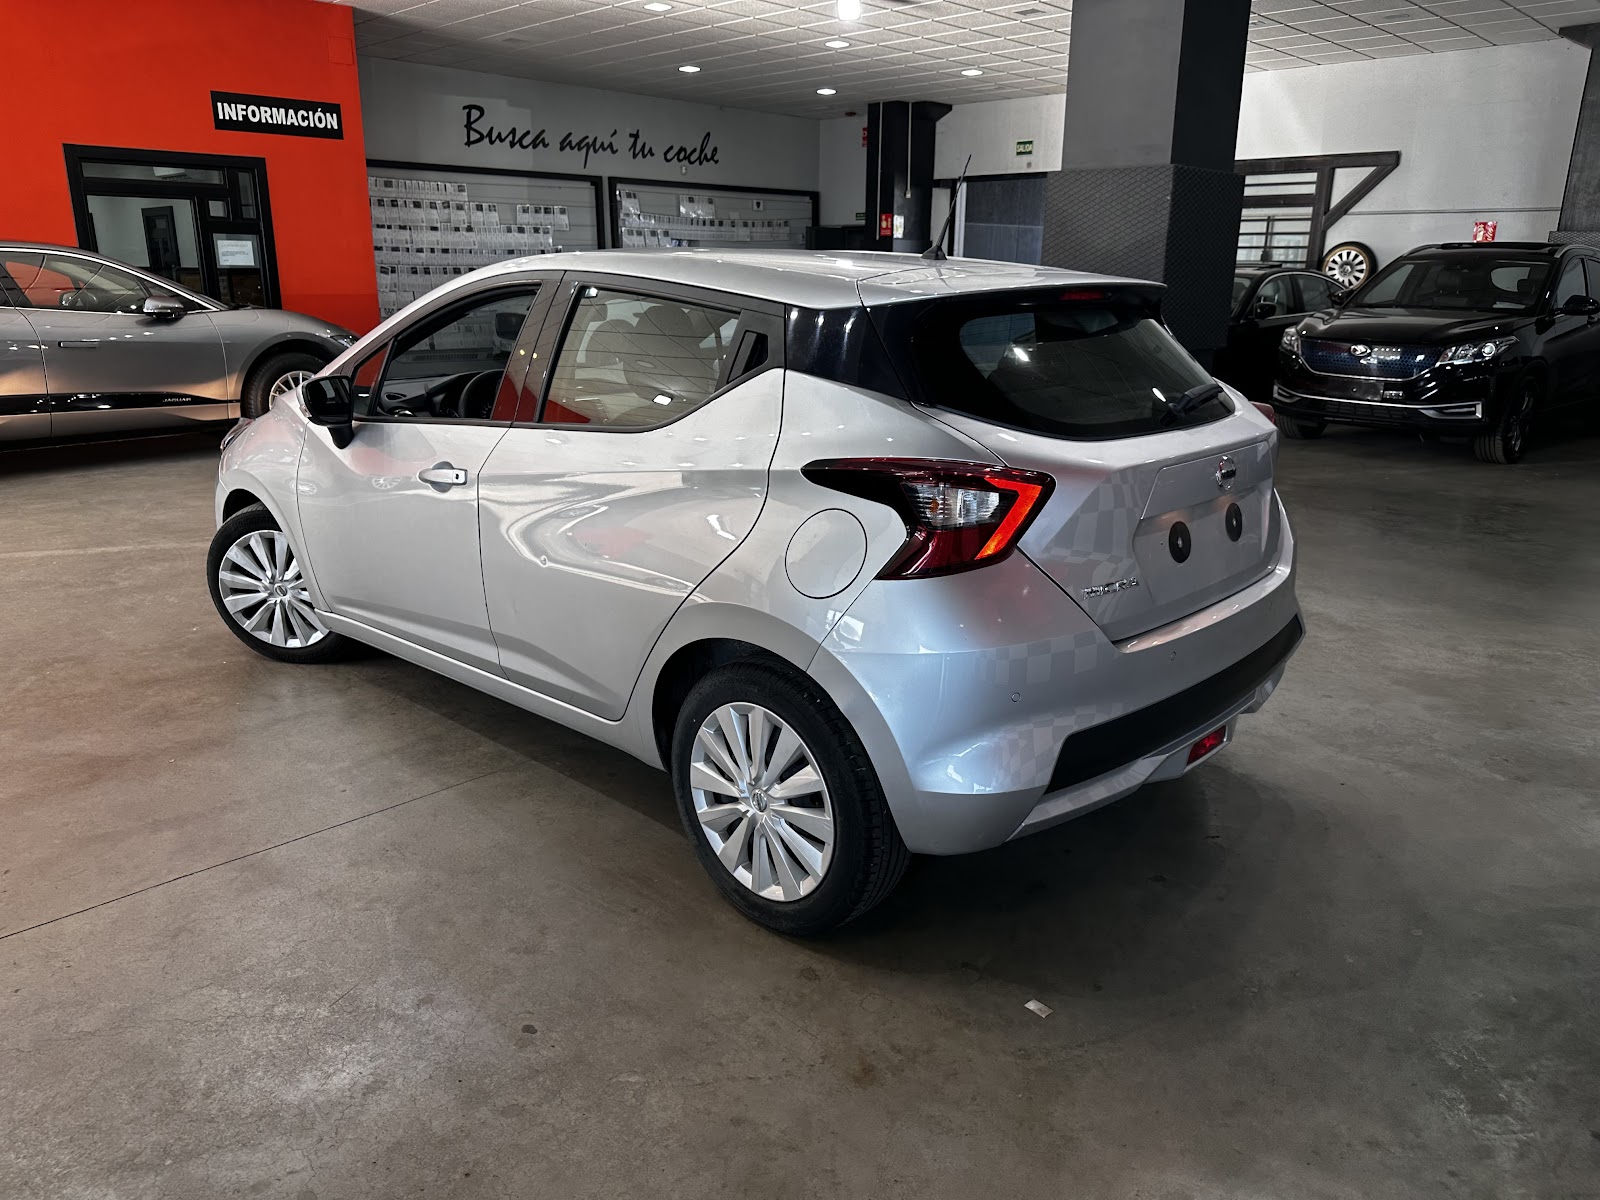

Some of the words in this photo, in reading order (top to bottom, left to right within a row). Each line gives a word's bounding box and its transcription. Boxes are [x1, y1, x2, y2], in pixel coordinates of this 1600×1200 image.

[216, 102, 339, 130] INFORMACIÓN
[462, 104, 550, 149] Busca
[559, 128, 619, 169] aquí
[628, 129, 655, 159] tu
[663, 131, 720, 166] coche
